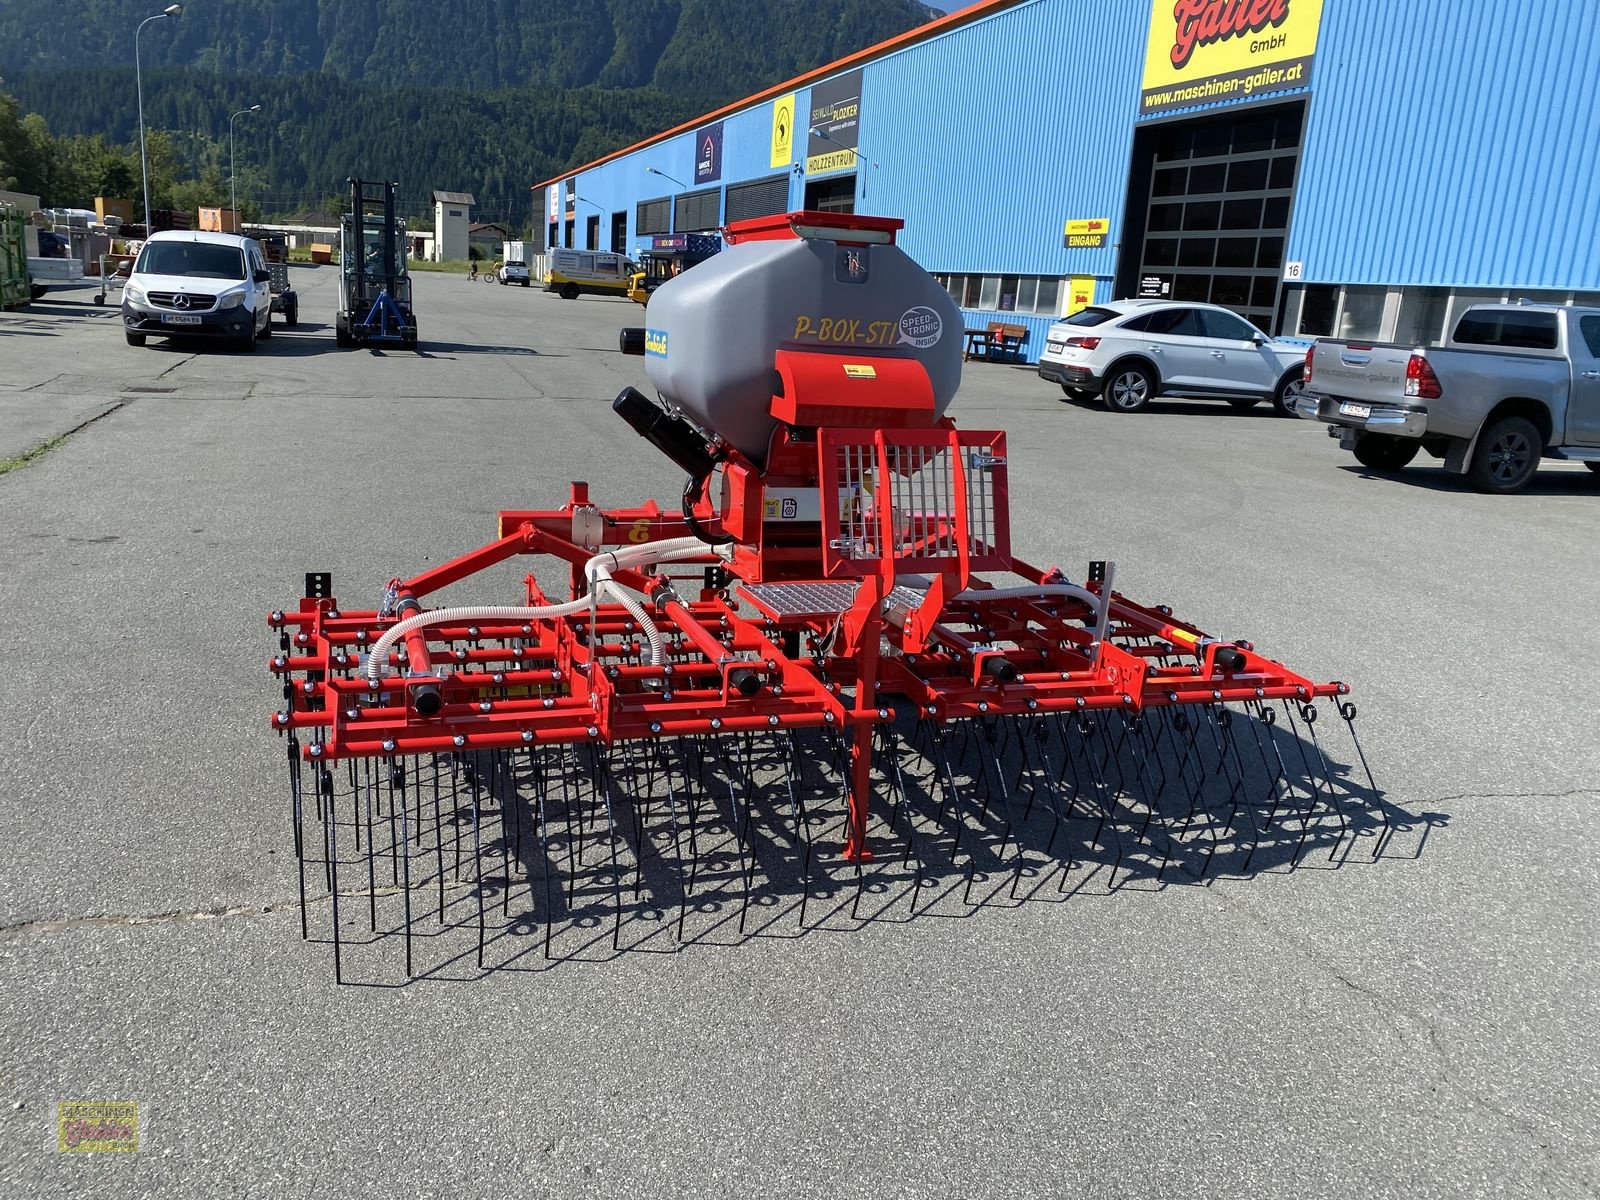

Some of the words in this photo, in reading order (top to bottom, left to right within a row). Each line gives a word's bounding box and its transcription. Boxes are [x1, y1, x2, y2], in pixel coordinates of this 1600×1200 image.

[1250, 33, 1287, 54] GmbH
[1145, 62, 1303, 107] www.maschinen-gailer.at
[808, 151, 855, 173] HOLZZENTRUM
[1068, 235, 1102, 247] EINGANG
[1288, 264, 1300, 277] 16
[902, 314, 934, 328] SPEED-
[907, 321, 939, 336] TRONIC
[914, 336, 938, 346] INSIDE
